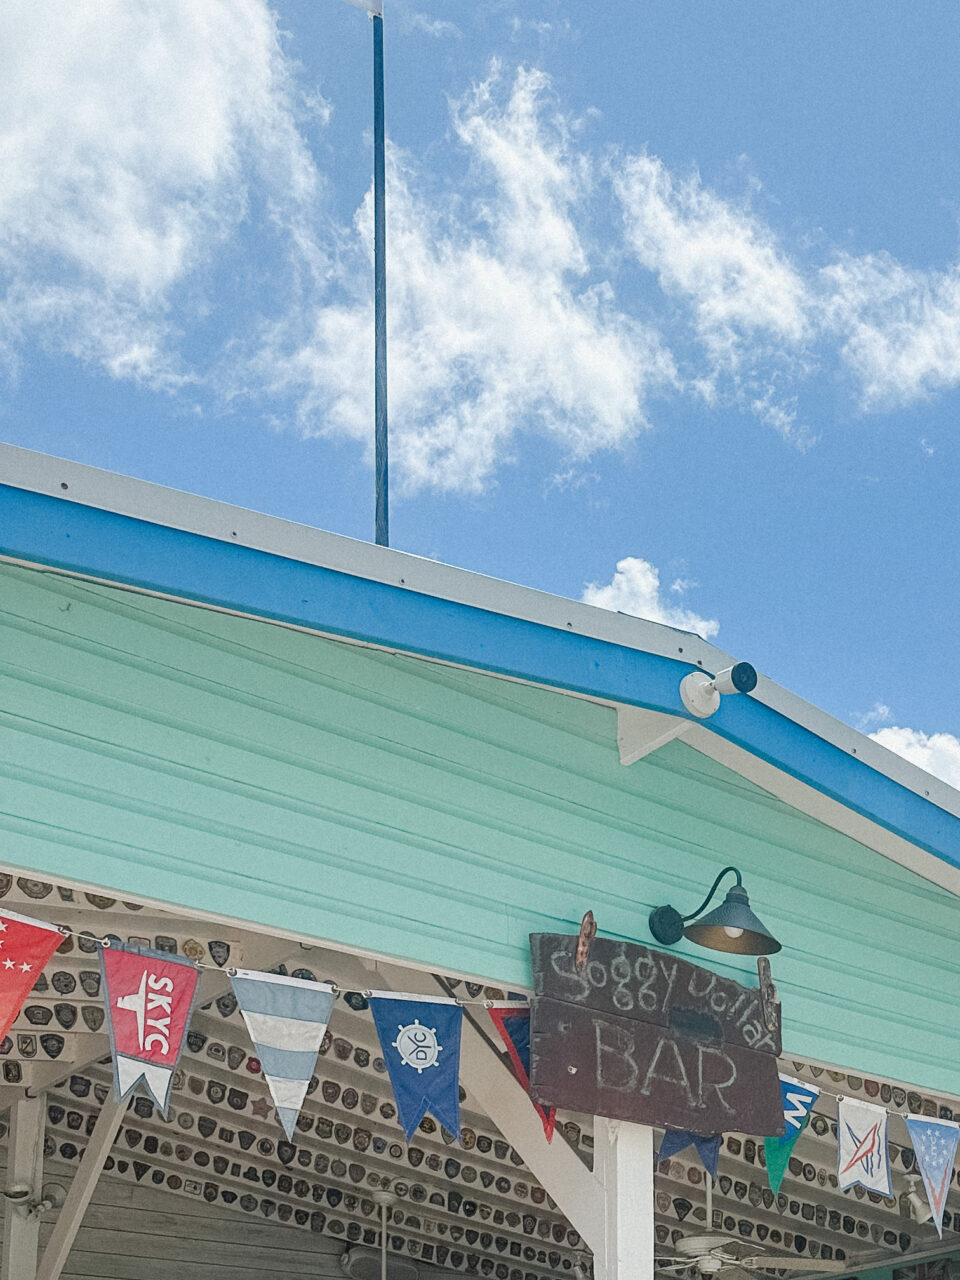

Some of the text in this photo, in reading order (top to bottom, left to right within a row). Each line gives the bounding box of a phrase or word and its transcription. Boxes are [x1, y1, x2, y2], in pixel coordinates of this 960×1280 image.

[144, 973, 174, 1056] SKYC
[549, 946, 677, 1012] Soggy
[407, 1031, 432, 1061] DYC
[592, 1016, 737, 1115] BAR
